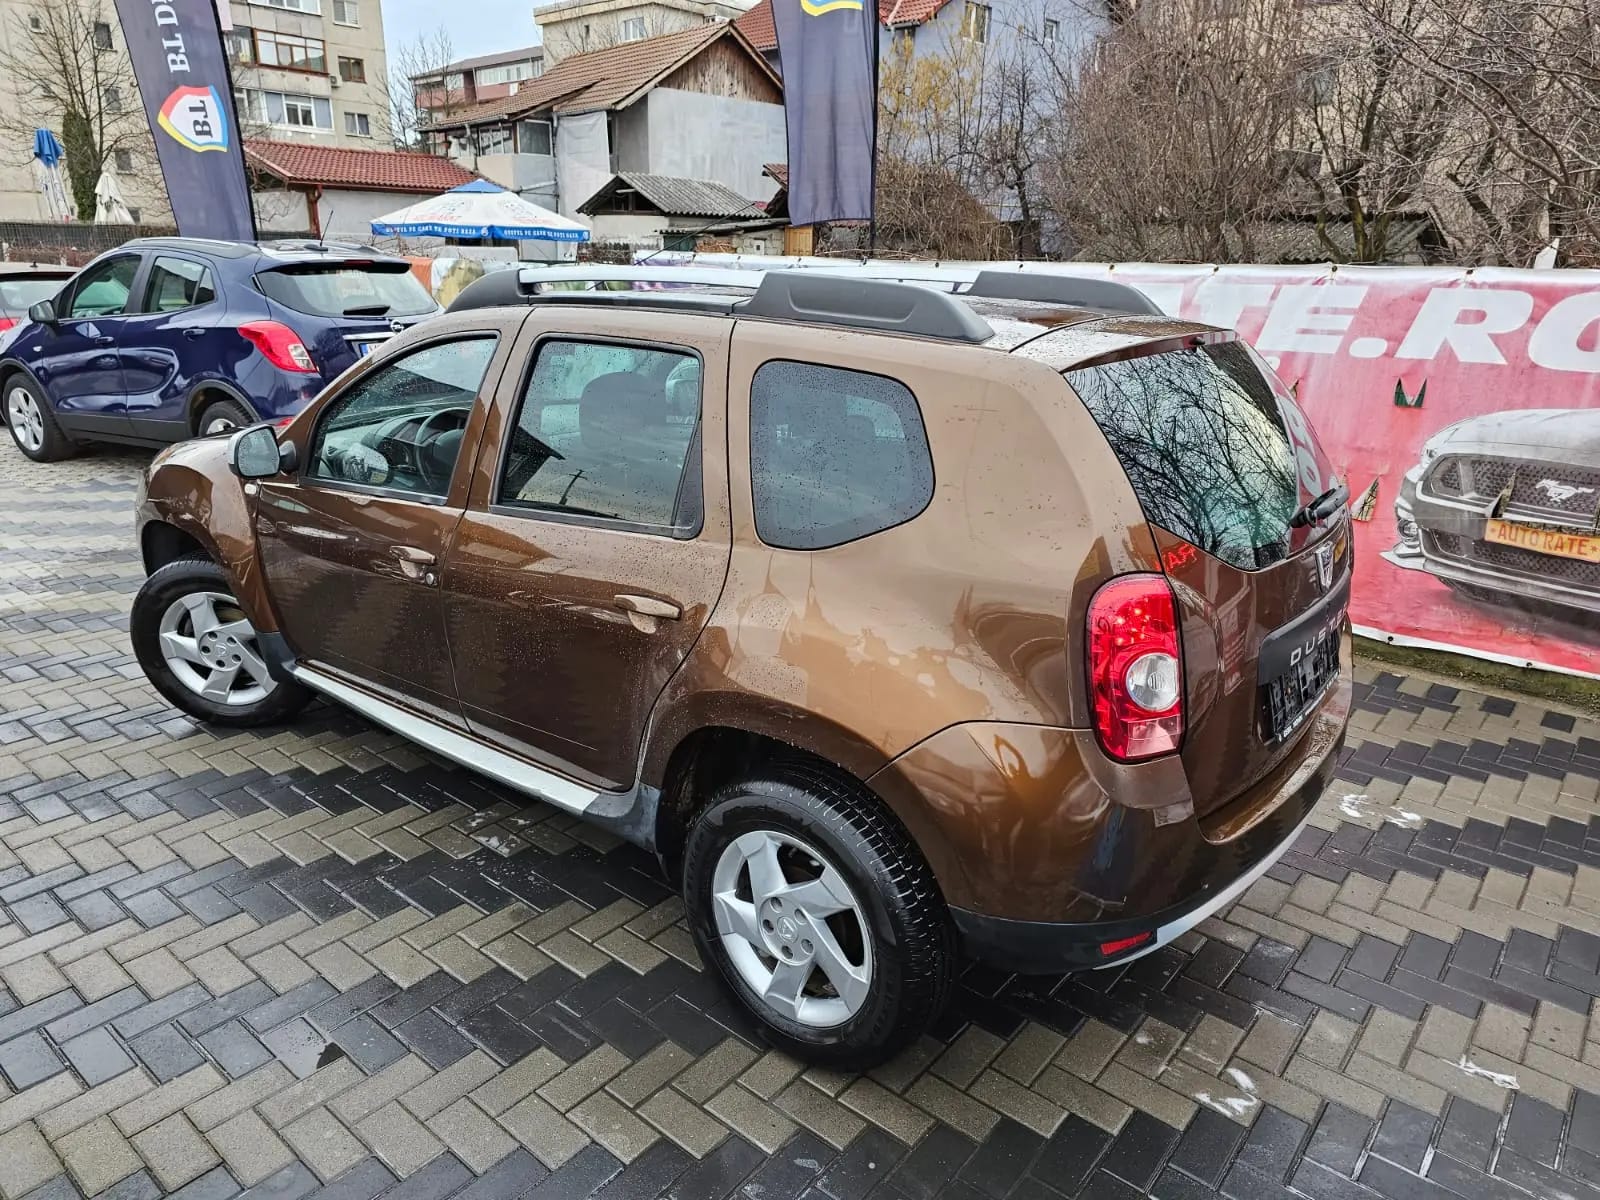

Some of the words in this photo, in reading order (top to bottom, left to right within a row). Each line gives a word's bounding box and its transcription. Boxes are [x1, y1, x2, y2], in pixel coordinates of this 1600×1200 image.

[150, 0, 179, 27] D
[161, 33, 190, 73] BL
[188, 99, 213, 138] BL
[1497, 522, 1539, 546] AUTO
[1543, 531, 1590, 556] RATE
